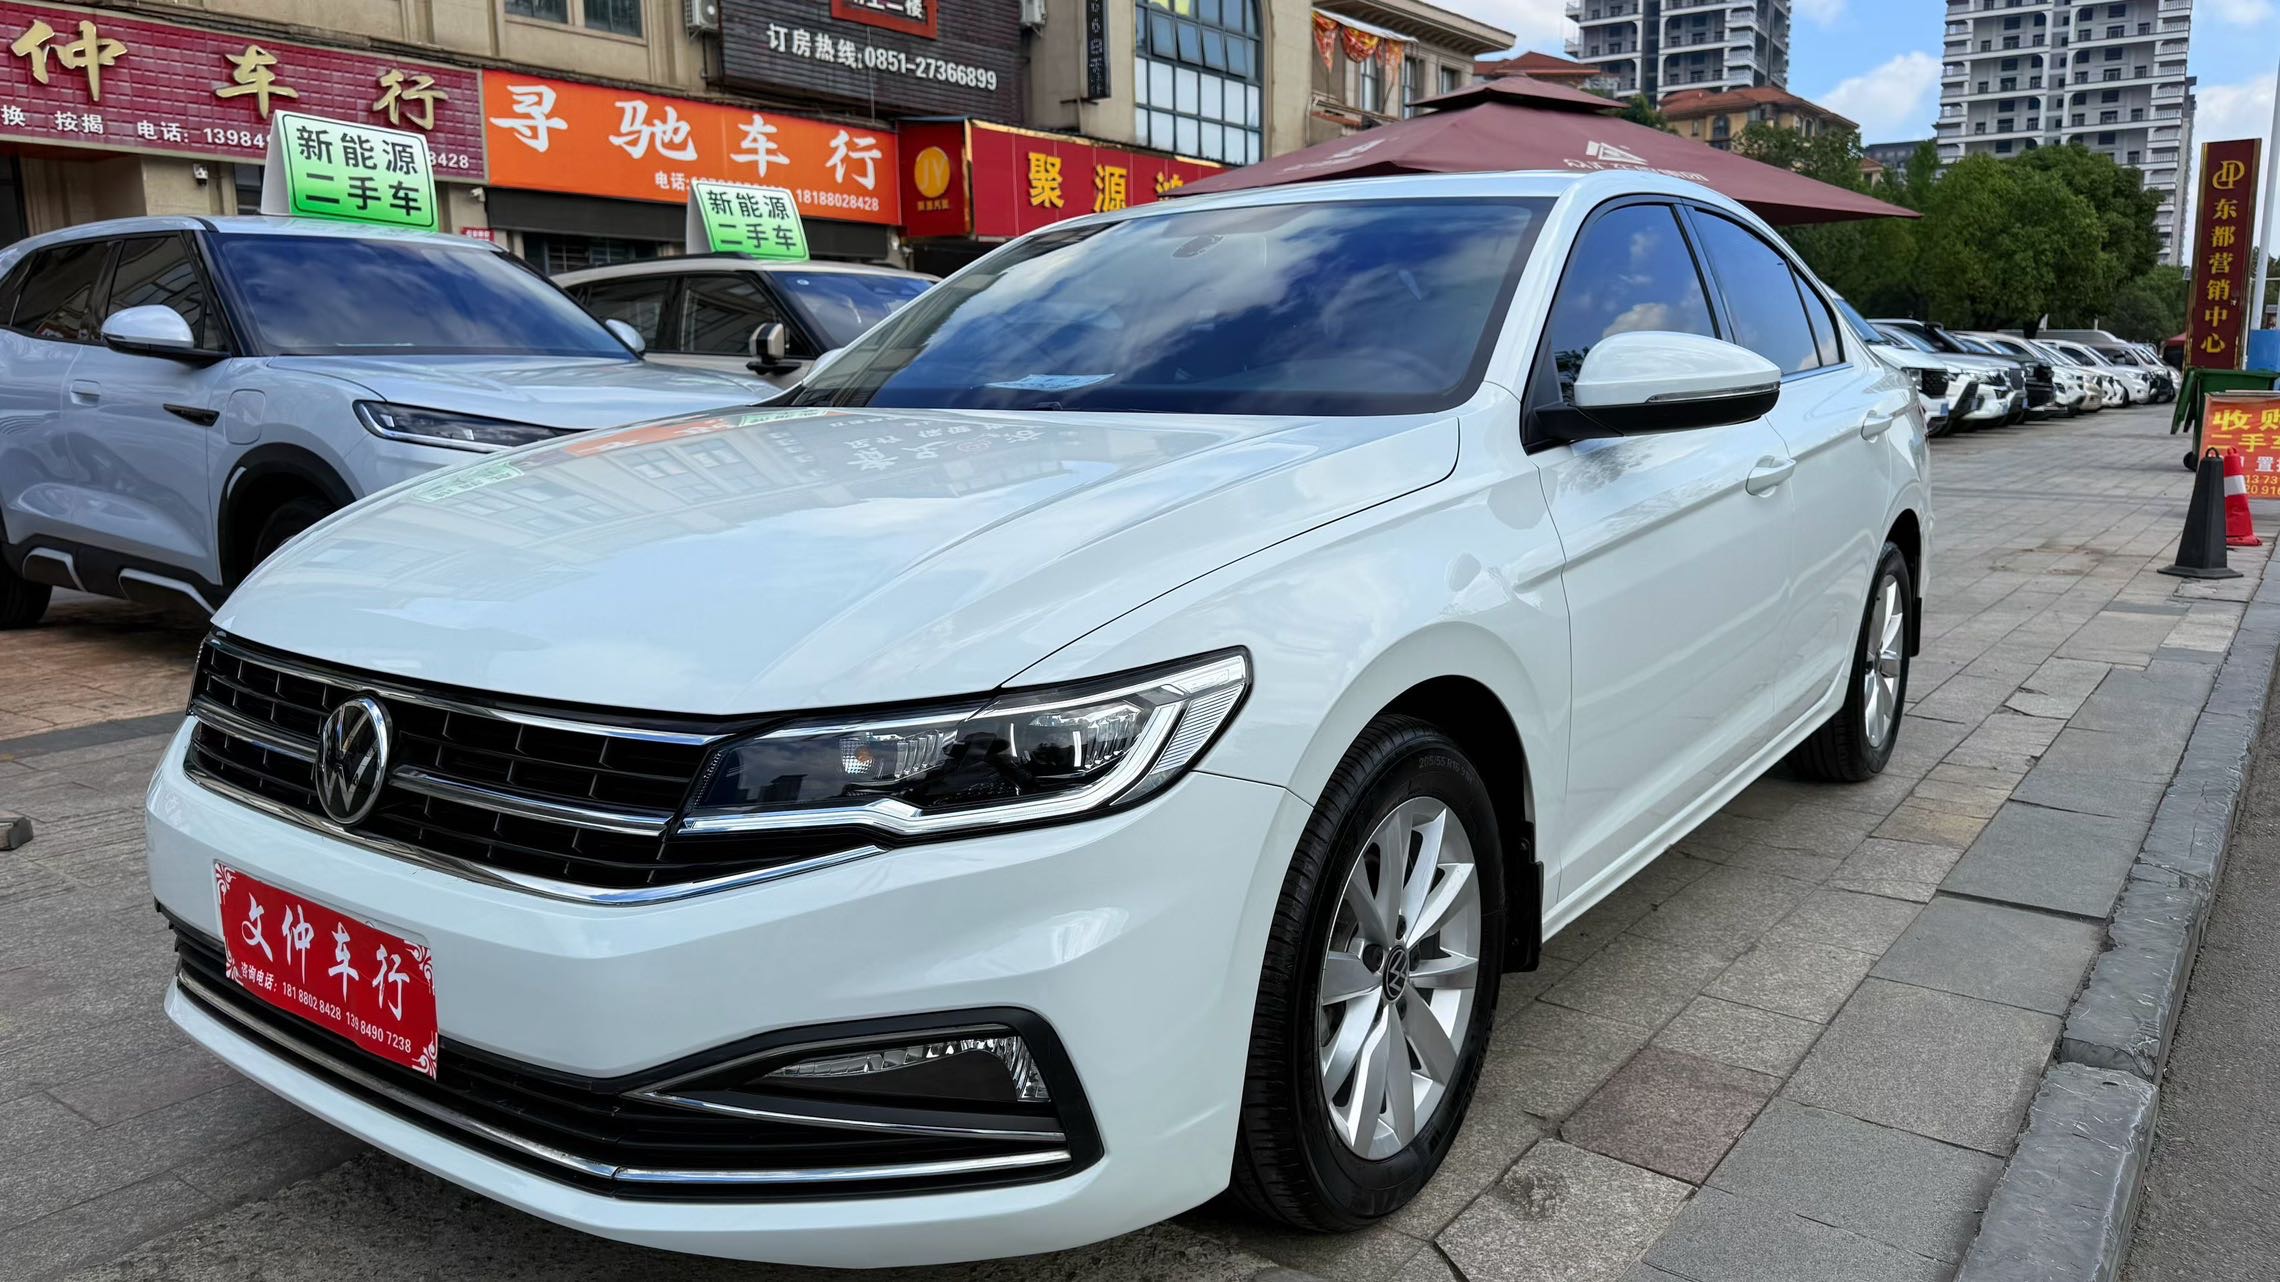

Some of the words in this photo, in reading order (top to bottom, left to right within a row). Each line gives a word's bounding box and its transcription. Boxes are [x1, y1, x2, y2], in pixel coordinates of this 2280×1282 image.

[11, 19, 448, 131] 仲车行
[0, 104, 26, 127] 换
[54, 110, 104, 135] 按揭
[137, 120, 189, 143] 电话：
[203, 127, 272, 149] 13984
[296, 125, 418, 176] 新能源
[489, 85, 882, 190] 寻驰车行
[304, 172, 422, 216] 二手车
[706, 190, 791, 220] 新能源
[796, 189, 879, 211] 18188028428
[718, 223, 797, 250] 二手车
[2201, 198, 2238, 353] 东都营销中心
[241, 892, 410, 1021] 文仲车行
[282, 982, 297, 1000] 181
[298, 989, 318, 1011] 8802
[319, 1000, 342, 1021] 8428
[346, 1011, 360, 1031] 139
[360, 1020, 384, 1043] 8490
[386, 1030, 412, 1054] 7238
